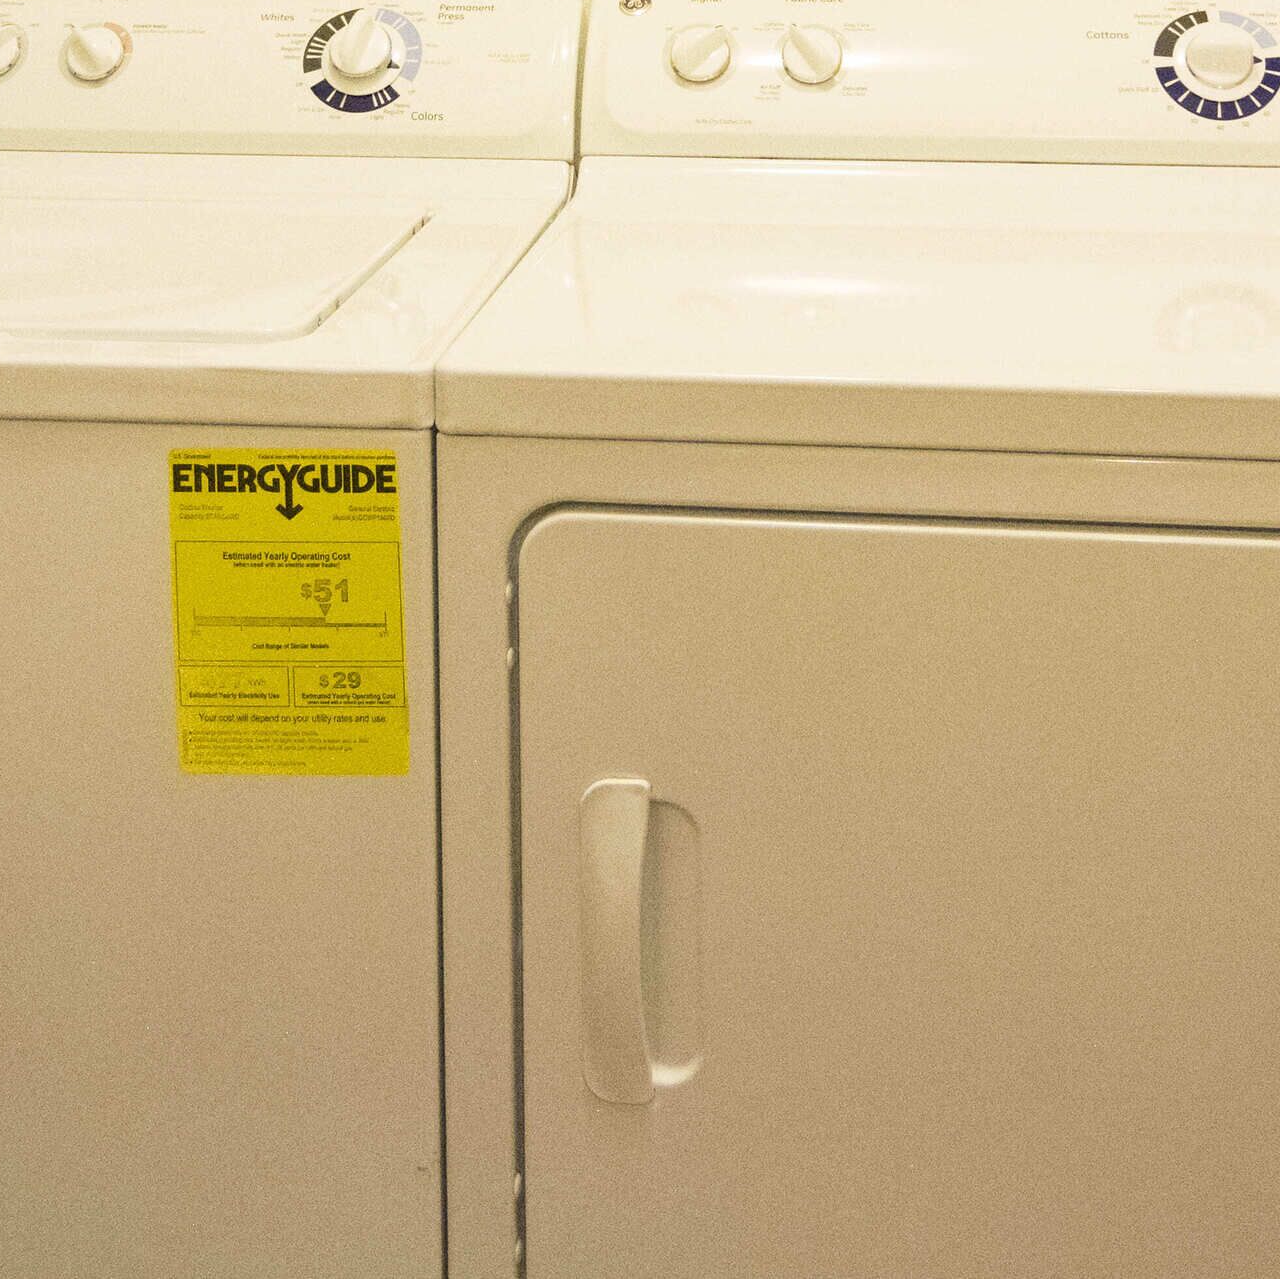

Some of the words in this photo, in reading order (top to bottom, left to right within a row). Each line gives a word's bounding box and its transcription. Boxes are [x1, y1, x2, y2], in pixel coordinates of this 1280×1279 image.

[439, 3, 495, 12] Permanent
[260, 13, 295, 22] Whites
[437, 12, 465, 21] Press
[1085, 30, 1129, 40] Cottons
[410, 111, 444, 121] Colors
[173, 464, 397, 496] ENERGYGUIDE
[222, 551, 262, 561] Estimated
[263, 551, 289, 563] Yearly
[290, 551, 330, 563] Operating
[331, 551, 352, 562] Cost
[300, 578, 349, 603] $51
[301, 692, 331, 700] Estimated
[351, 692, 381, 702] Operating
[198, 713, 217, 722] Your
[218, 713, 234, 722] cost
[236, 713, 249, 722] will
[250, 713, 279, 725] depend
[281, 715, 291, 723] on
[293, 716, 309, 725] your
[311, 713, 332, 725] utility
[333, 715, 353, 723] rates
[355, 714, 369, 723] and
